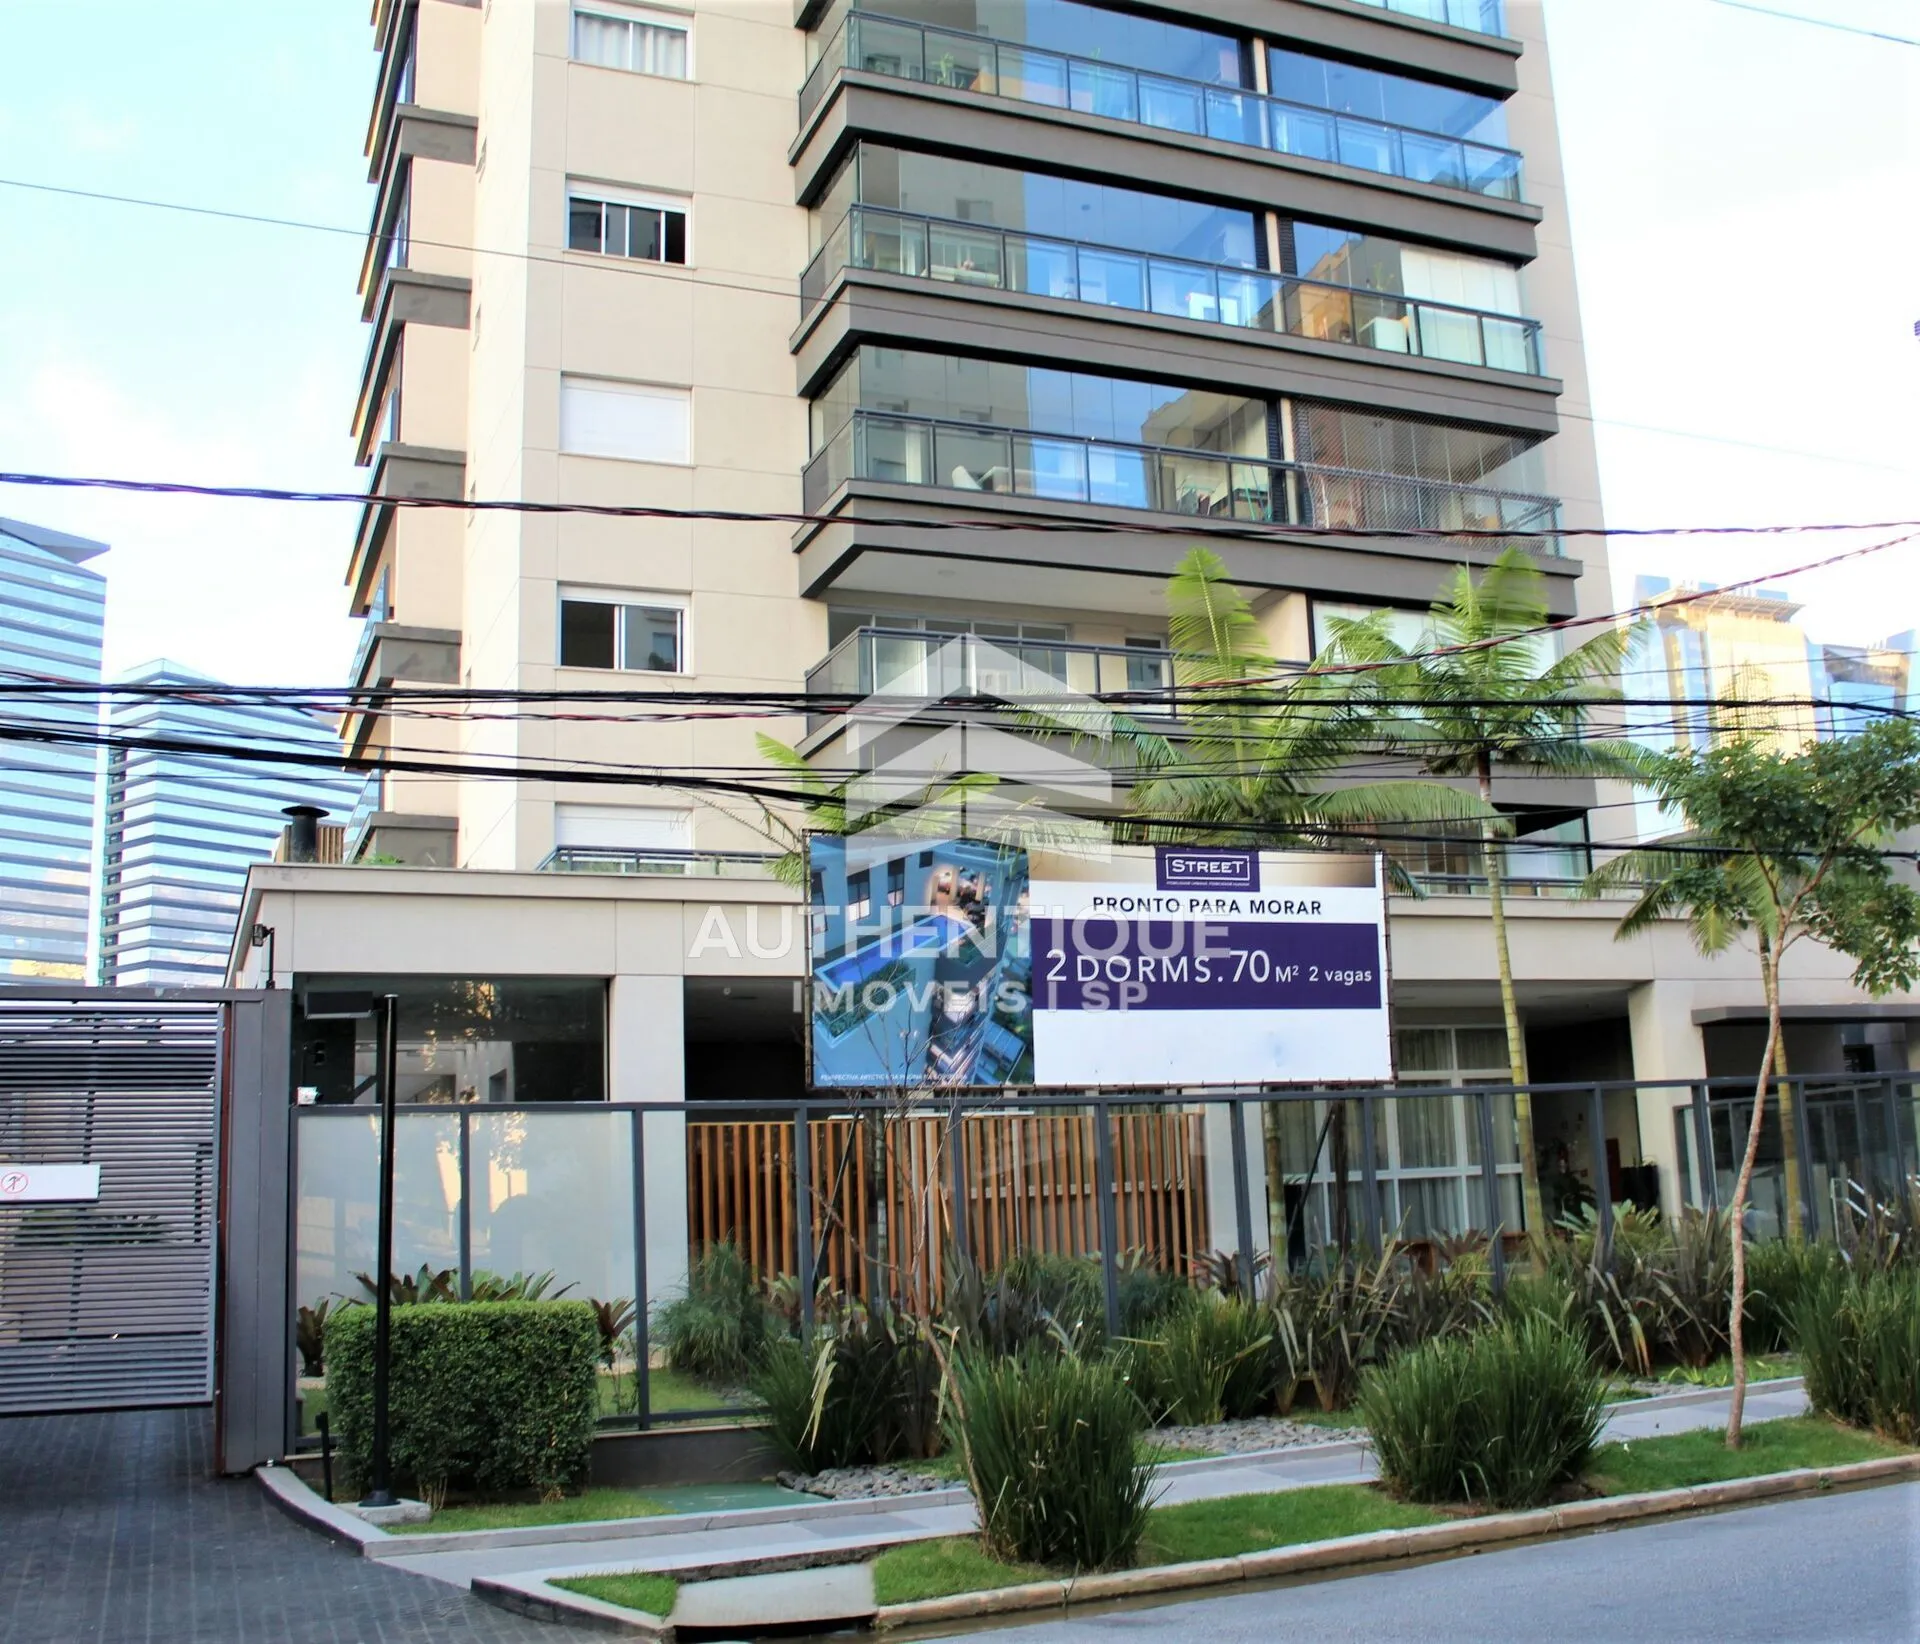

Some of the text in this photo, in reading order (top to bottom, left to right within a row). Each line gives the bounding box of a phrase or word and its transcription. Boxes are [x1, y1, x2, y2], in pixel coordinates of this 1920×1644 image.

[1092, 896, 1322, 915] PRONTO PARA MORAR
[1046, 949, 1068, 982] 2
[1229, 949, 1270, 983] 70
[1308, 965, 1319, 982] 2
[1324, 969, 1372, 986] vagas
